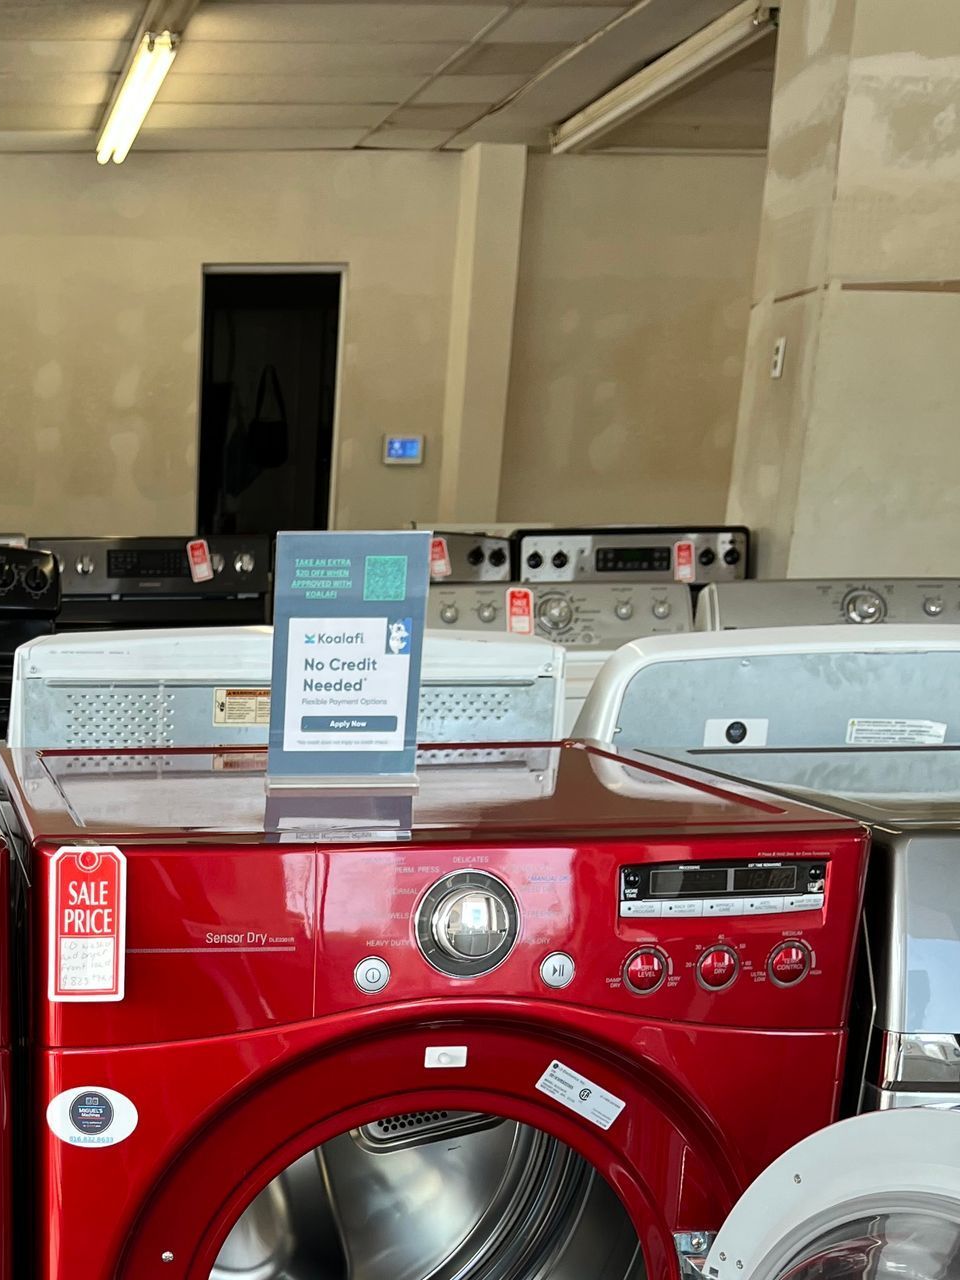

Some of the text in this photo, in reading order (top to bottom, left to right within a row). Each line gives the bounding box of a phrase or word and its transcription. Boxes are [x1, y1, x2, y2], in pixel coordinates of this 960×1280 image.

[305, 591, 337, 599] KOALAFI
[318, 633, 364, 644] Koalafi
[304, 657, 377, 671] No Credit
[329, 698, 358, 706] Payment
[360, 698, 388, 706] Options
[329, 720, 350, 729] Apply
[68, 881, 108, 905] SALE
[64, 908, 112, 933] PRICE
[206, 932, 244, 944] Sensor
[247, 932, 267, 945] Dry
